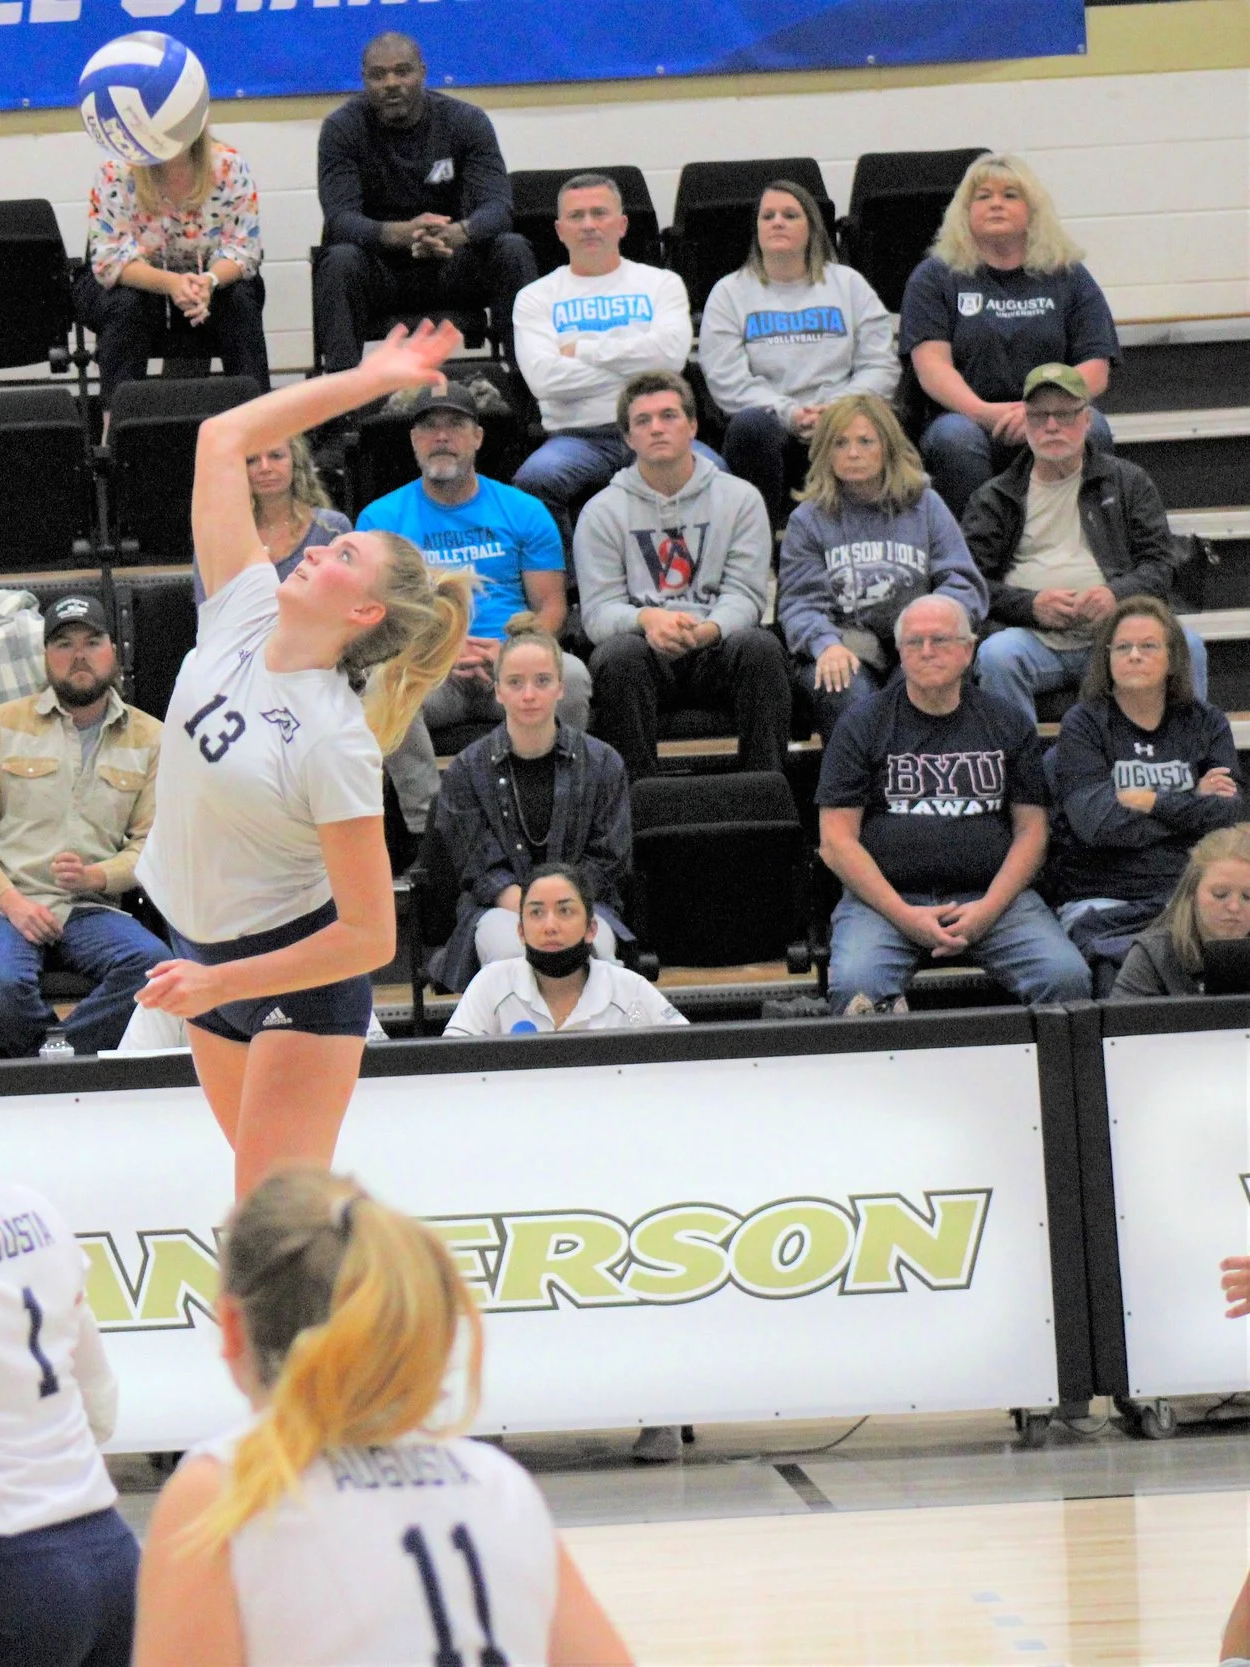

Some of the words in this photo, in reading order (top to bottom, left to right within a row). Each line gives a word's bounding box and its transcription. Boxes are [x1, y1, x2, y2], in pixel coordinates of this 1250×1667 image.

[554, 295, 651, 328] AUGUSTA
[986, 297, 1055, 312] AUGUSTA
[996, 308, 1046, 319] UNIVERSITY
[745, 307, 846, 342] AUGUSTA
[767, 332, 822, 345] VOLLEYBALL
[423, 527, 496, 551] AUGUSTA
[825, 542, 884, 572] CKSON
[184, 694, 246, 763] 13
[884, 750, 1005, 797] BYU
[1115, 762, 1191, 788] UGUST
[22, 1287, 59, 1398] 1
[402, 1522, 510, 1667] 11
